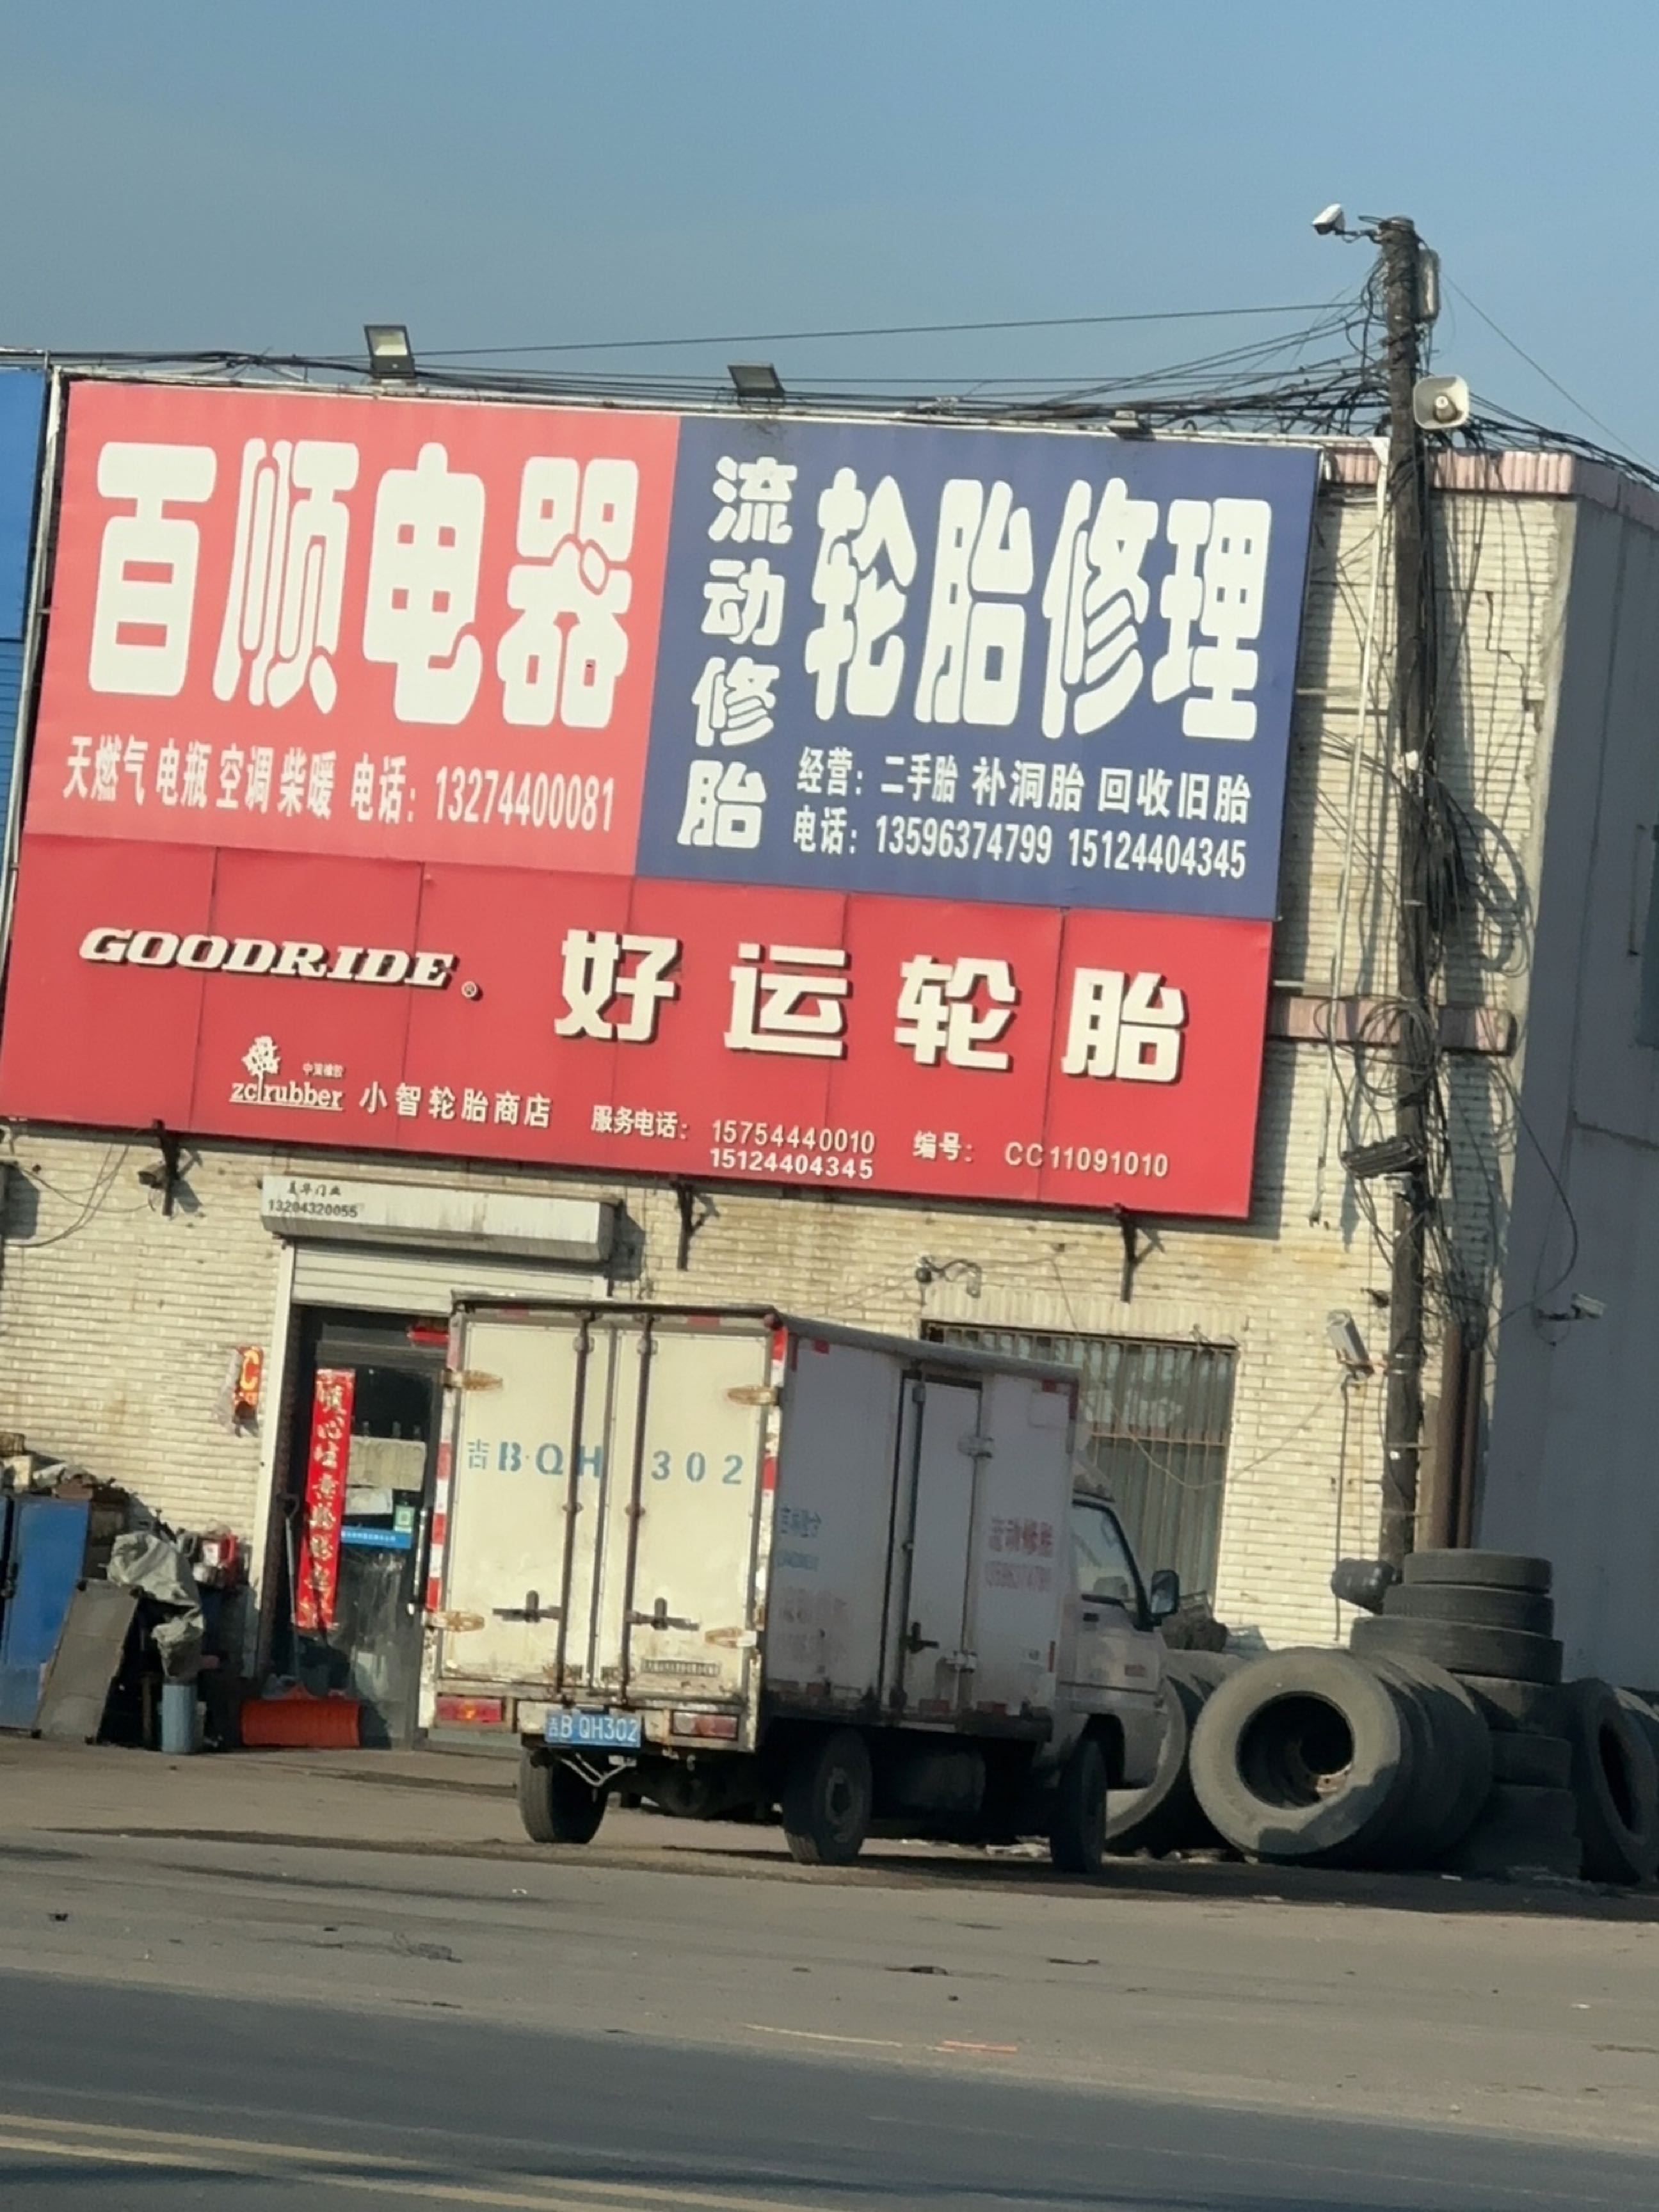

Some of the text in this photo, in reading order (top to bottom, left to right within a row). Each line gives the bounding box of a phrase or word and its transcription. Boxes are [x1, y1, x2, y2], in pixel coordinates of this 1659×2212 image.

[88, 437, 640, 728] 百顺电器
[805, 467, 1272, 741] 轮胎修理
[677, 455, 798, 849] 流动修胎
[62, 734, 149, 806] 天燃气
[155, 737, 213, 809] 电瓶
[216, 742, 275, 814] 空调
[277, 746, 337, 820] 柴暖
[436, 766, 616, 833] 13274400081
[881, 754, 958, 803] 二手胎
[972, 757, 1085, 812] 补洞胎
[1098, 768, 1251, 824] 回收旧胎
[876, 815, 1052, 864] 13596374799
[1069, 829, 1246, 879] 15124404345
[79, 927, 456, 988] GOODRIDE
[554, 929, 1185, 1084] 好运轮胎
[359, 1081, 551, 1128] 小智轮胎商店
[712, 1120, 876, 1155] 15754440010
[710, 1148, 874, 1180] 15124404345
